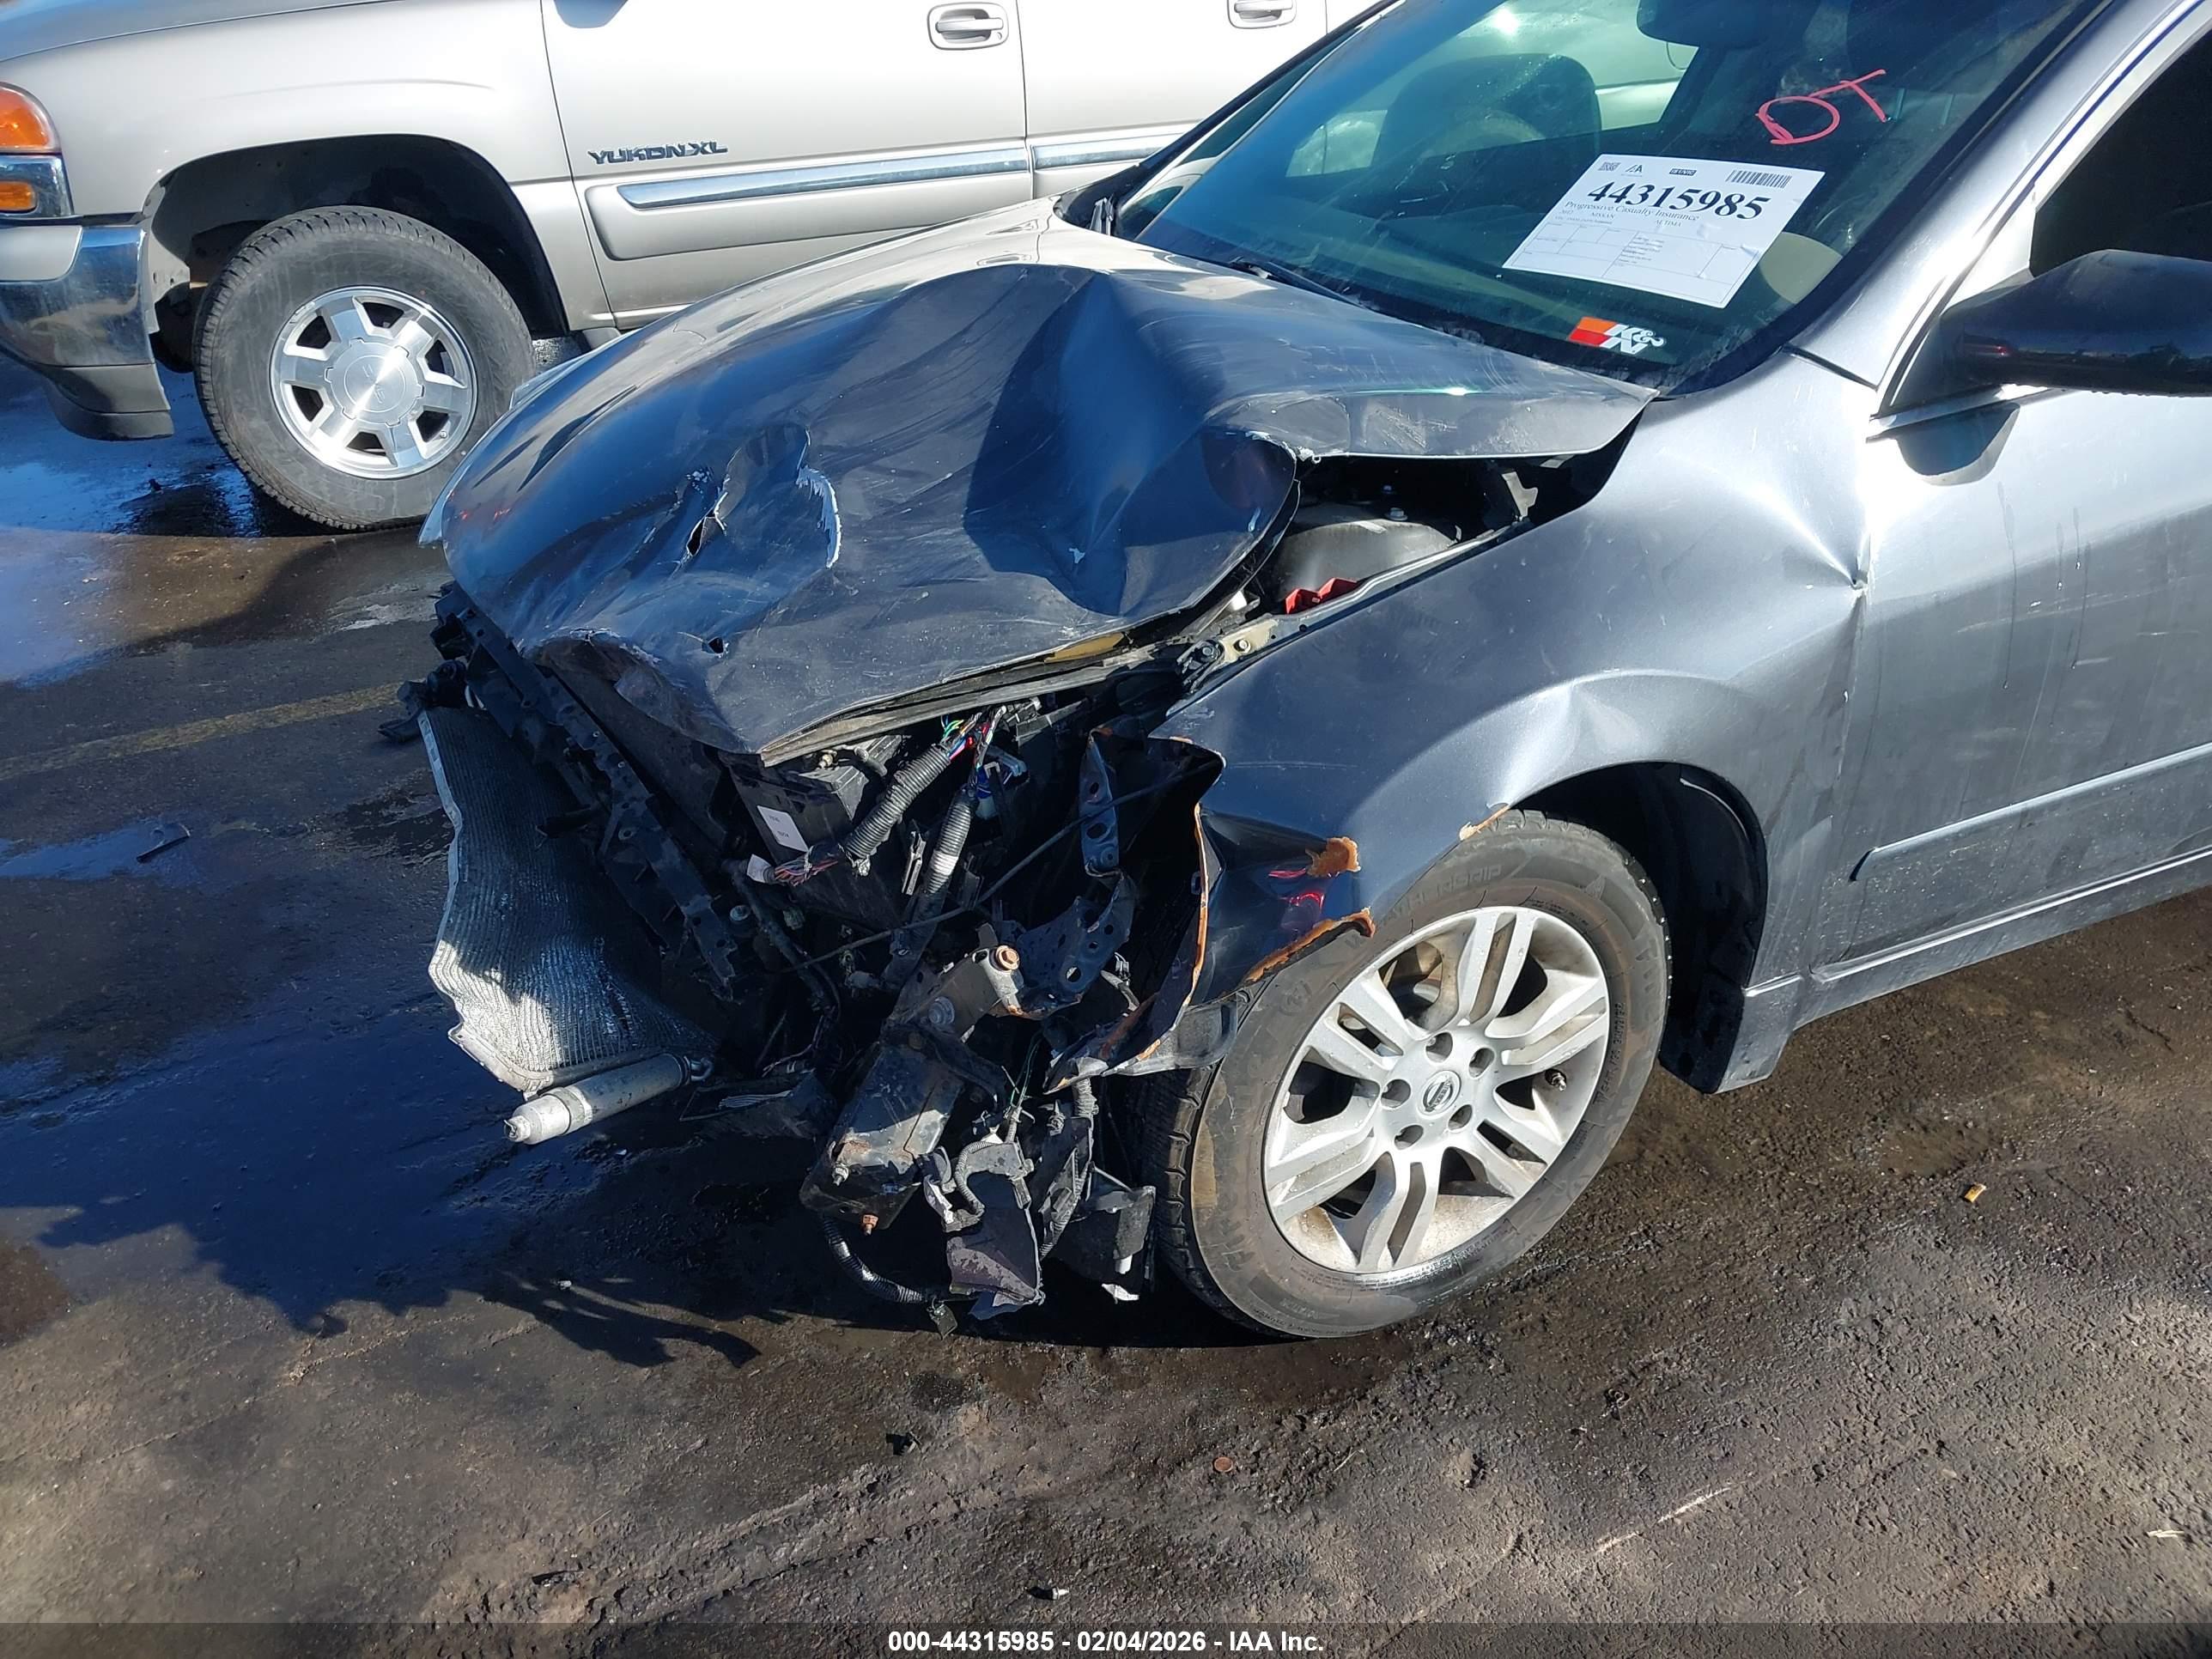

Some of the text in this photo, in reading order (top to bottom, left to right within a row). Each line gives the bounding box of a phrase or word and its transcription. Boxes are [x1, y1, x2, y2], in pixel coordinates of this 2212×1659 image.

[587, 140, 729, 165] YUKON XL
[1565, 200, 1700, 221] Progressive Casualty Insurance
[1588, 180, 1772, 221] 44315985
